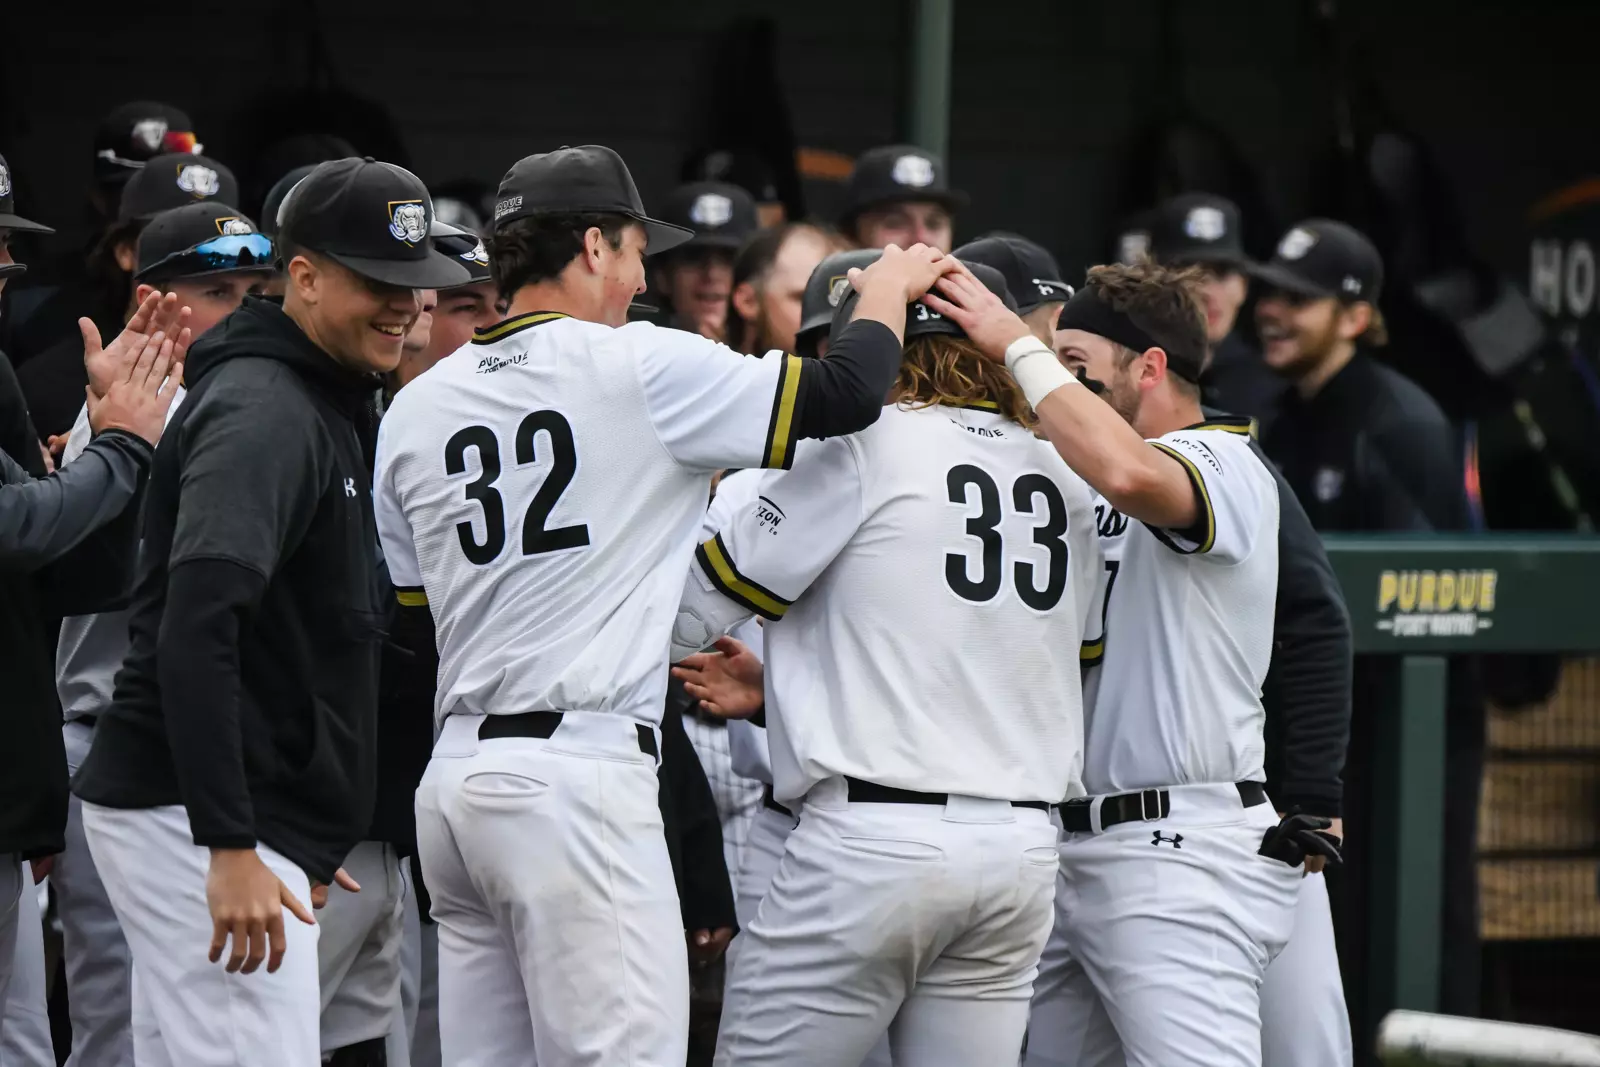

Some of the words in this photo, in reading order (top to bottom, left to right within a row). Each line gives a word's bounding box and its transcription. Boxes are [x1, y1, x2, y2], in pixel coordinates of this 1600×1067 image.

[444, 409, 591, 566] 32
[945, 463, 1069, 612] 33
[1377, 570, 1498, 612] PURDUE
